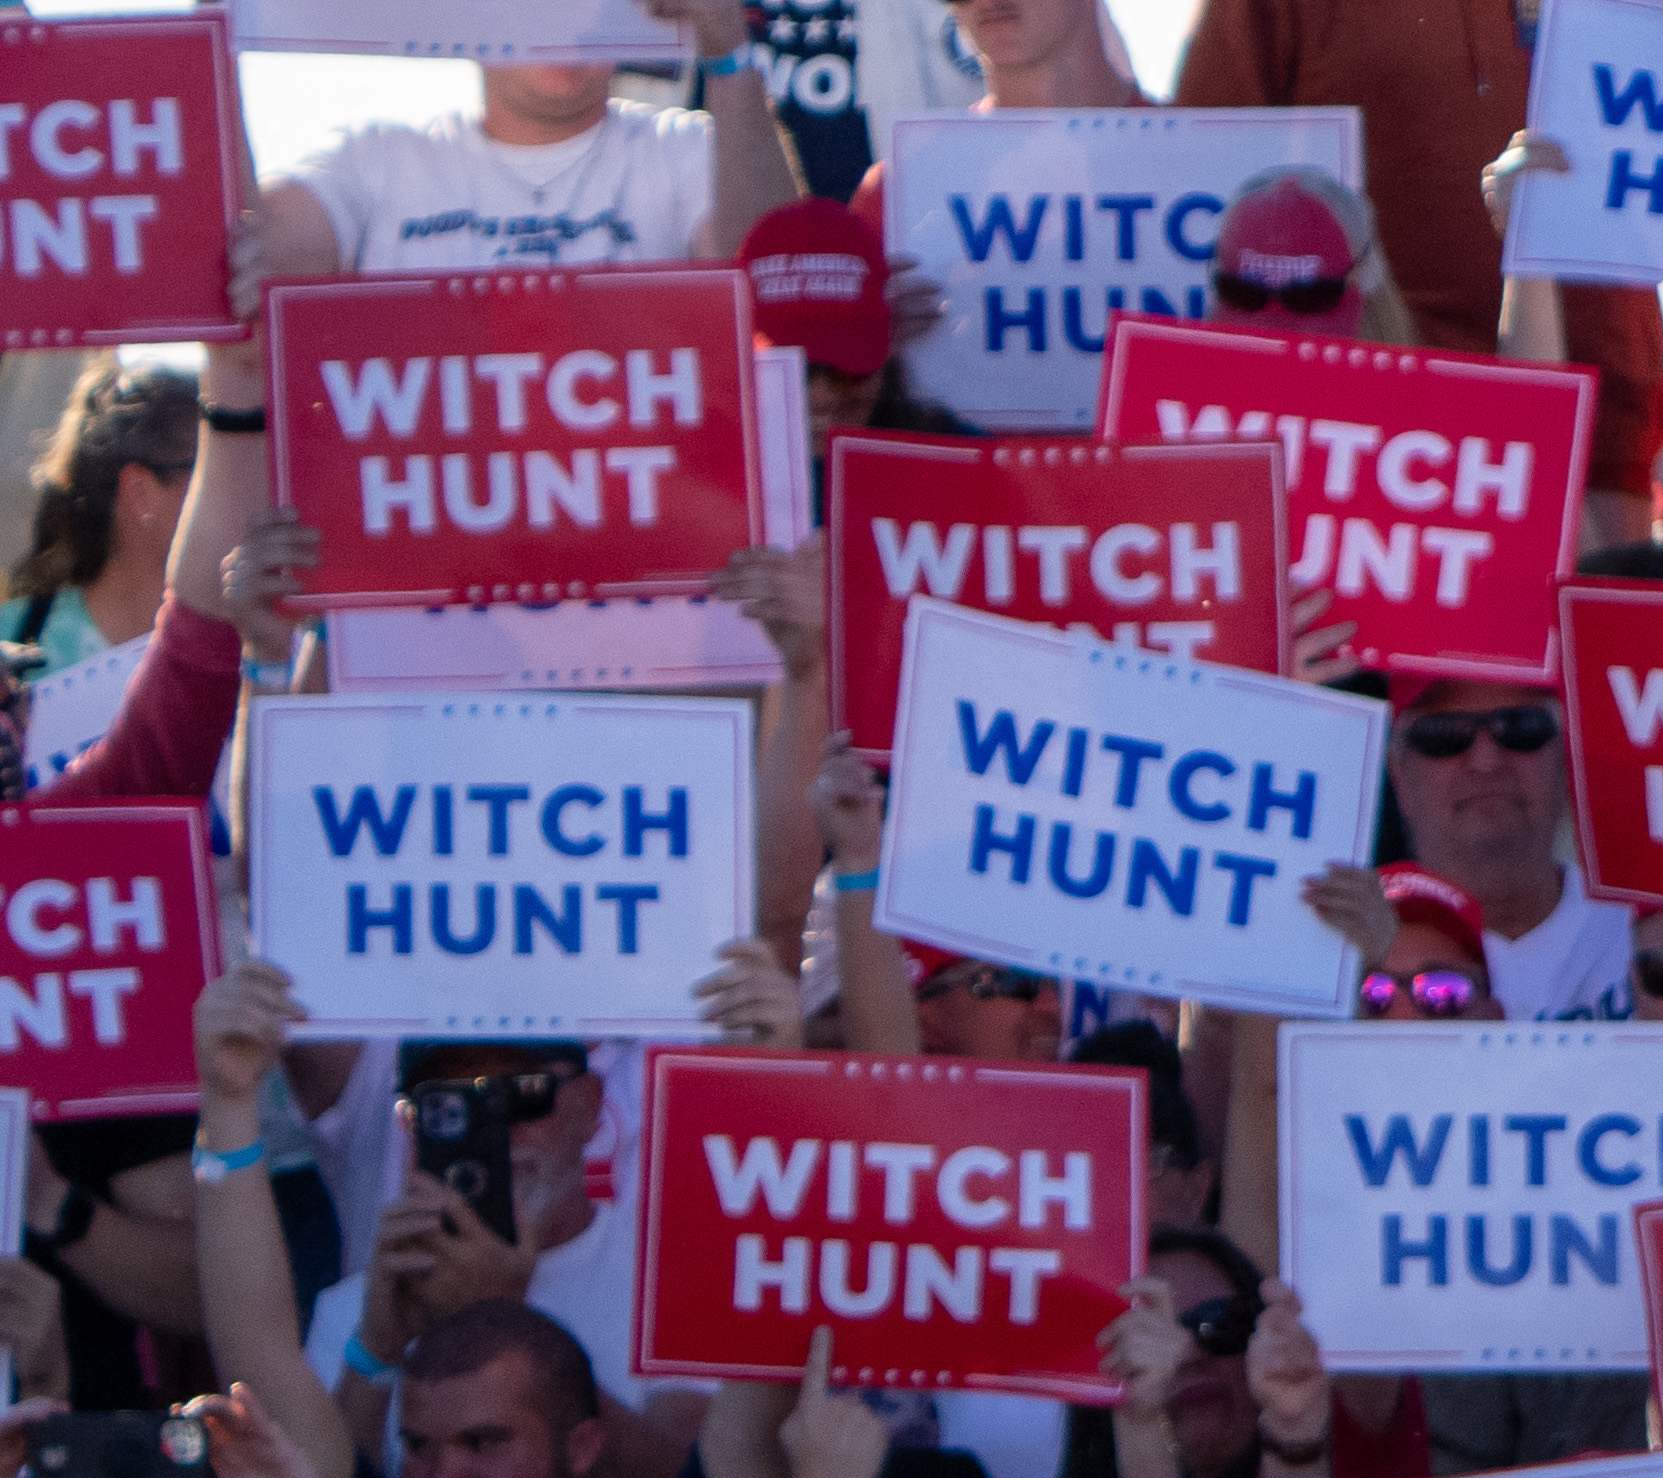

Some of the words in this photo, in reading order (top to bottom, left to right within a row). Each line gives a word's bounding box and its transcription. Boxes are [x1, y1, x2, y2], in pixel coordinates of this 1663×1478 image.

[0, 198, 156, 275] NT
[950, 193, 1224, 264] WITC
[983, 287, 1207, 353] HUN
[320, 346, 704, 440] WITCH
[361, 446, 675, 535] HUNT
[872, 518, 1242, 603] WITCH
[1291, 515, 1490, 607] UNT
[957, 699, 1318, 842] WITCH
[312, 785, 689, 857] WITCH
[968, 804, 1277, 927] HUNT
[347, 883, 659, 955] HUNT
[0, 968, 141, 1050] NT
[705, 1136, 1093, 1230] WITCH
[733, 1236, 1060, 1326] HUNT
[1381, 1213, 1619, 1288] HUN
